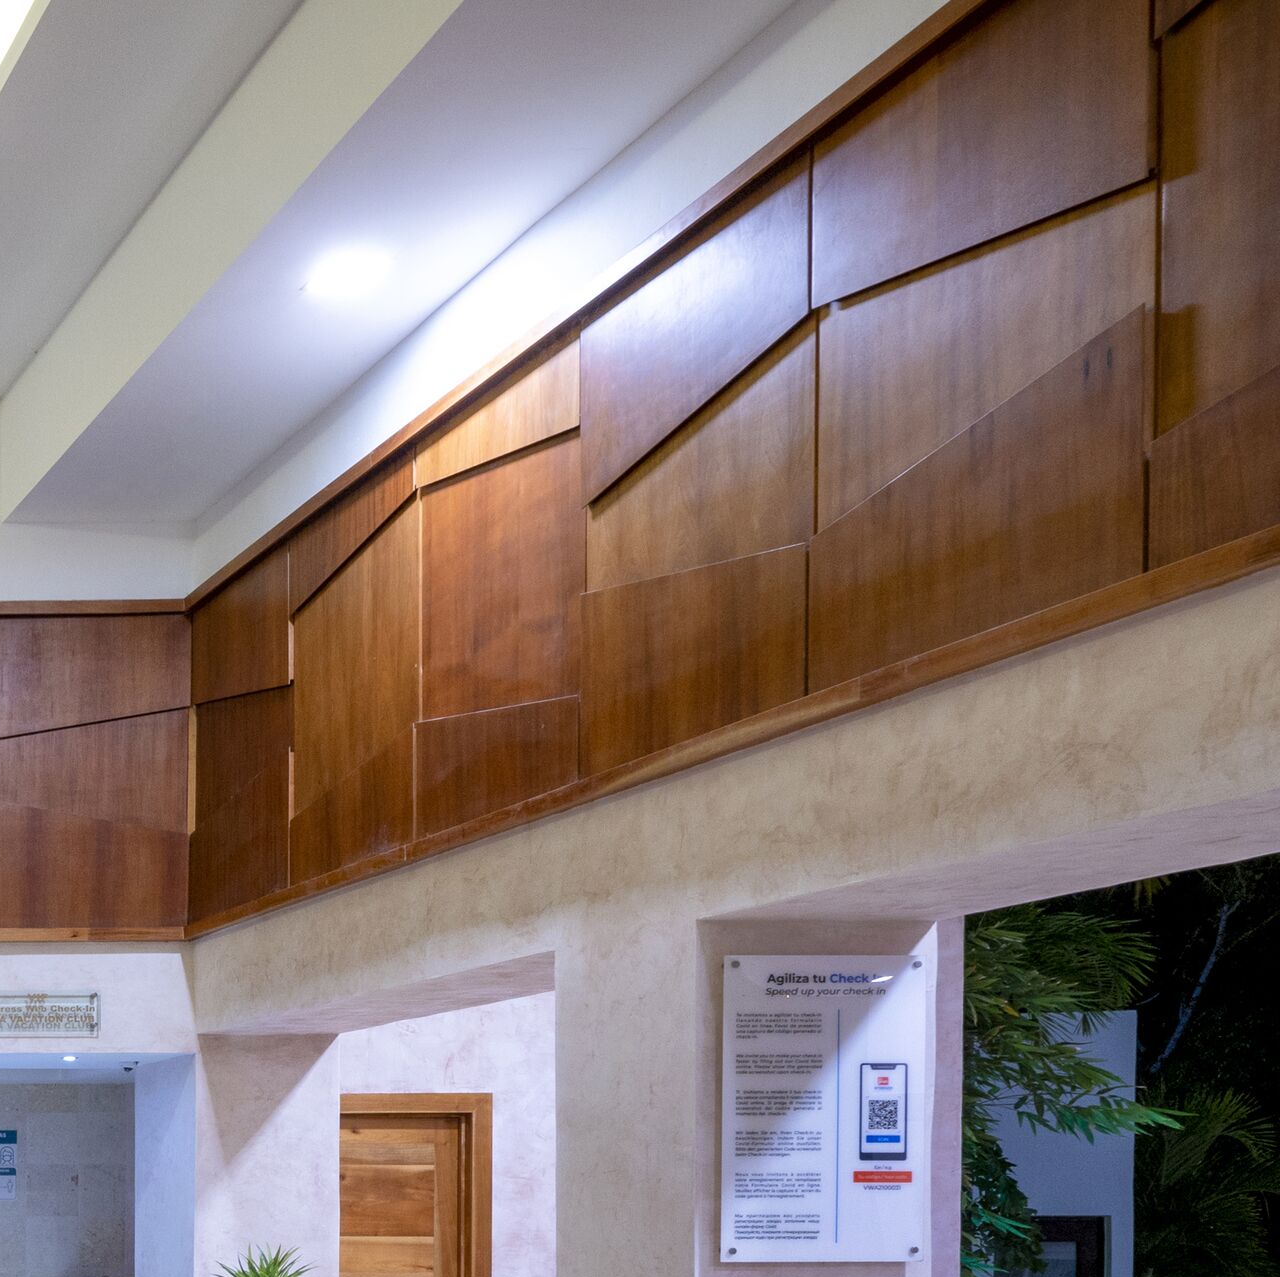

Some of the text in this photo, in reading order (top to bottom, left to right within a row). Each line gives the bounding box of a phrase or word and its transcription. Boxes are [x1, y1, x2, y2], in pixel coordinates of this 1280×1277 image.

[767, 973, 809, 986] Agiliza
[813, 974, 826, 984] tu
[830, 973, 869, 984] Check
[766, 988, 798, 996] Speed
[842, 988, 874, 996] check
[876, 988, 886, 996] in
[11, 1016, 64, 1024] VACATION
[66, 1016, 95, 1024] CLUB
